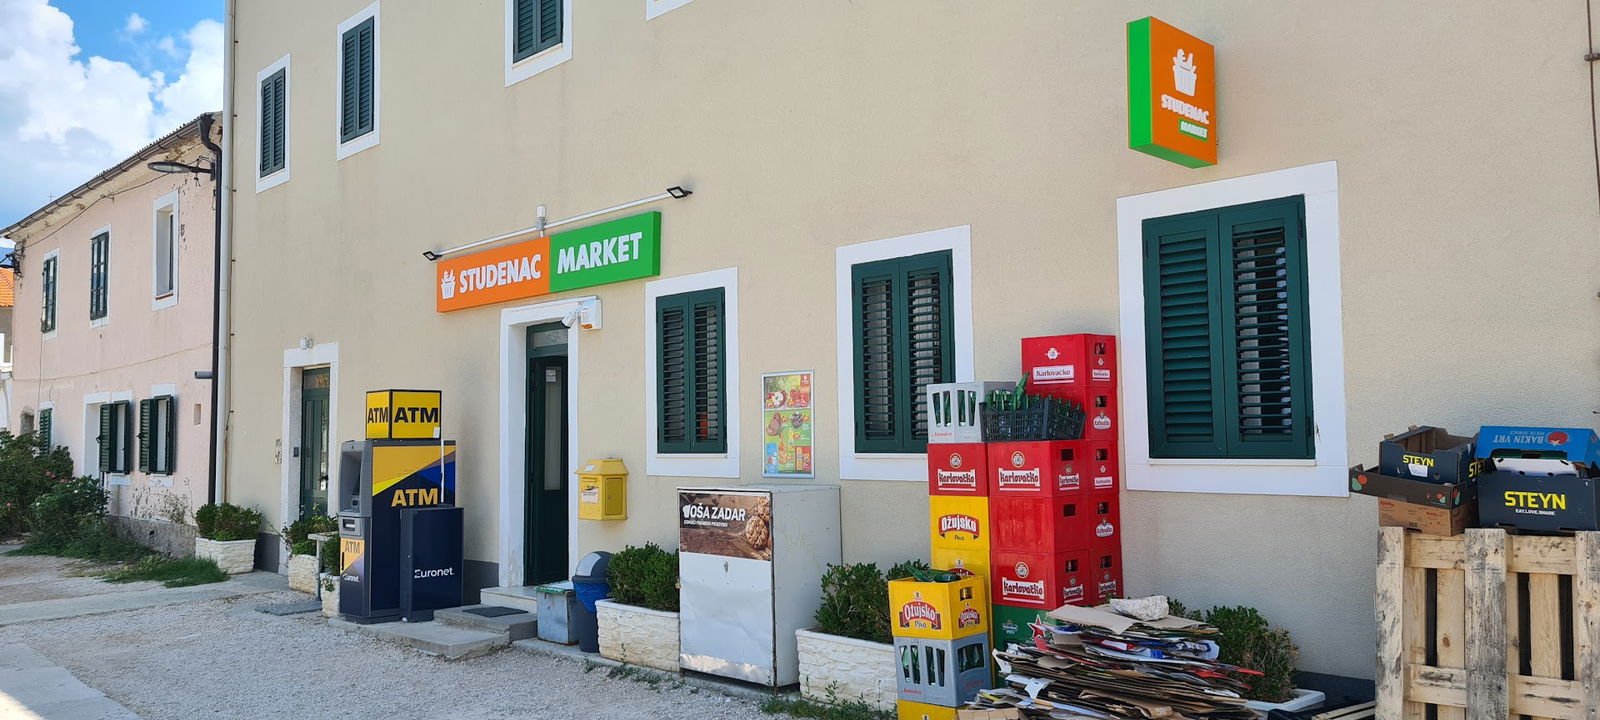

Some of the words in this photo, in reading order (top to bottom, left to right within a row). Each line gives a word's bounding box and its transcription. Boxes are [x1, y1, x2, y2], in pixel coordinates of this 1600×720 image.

[1161, 94, 1210, 125] STUDENAC
[459, 254, 542, 294] STUDENAC
[557, 232, 643, 275] MARKET
[1035, 369, 1071, 378] Karlovačko
[367, 407, 389, 424] ATM
[393, 407, 439, 424] ATM
[1492, 434, 1512, 444] VRT
[1512, 434, 1545, 444] BAKIN
[1402, 454, 1435, 468] STEYN
[939, 470, 976, 485] Karlovačko
[1000, 470, 1040, 485] Karlovačko
[390, 488, 439, 508] ATM
[1504, 491, 1567, 510] STEYN
[711, 507, 746, 522] ZADAR
[941, 514, 977, 533] Ožujsko
[345, 542, 361, 555] ATM
[414, 566, 454, 579] Euronet
[1003, 581, 1044, 597] Karlovačko
